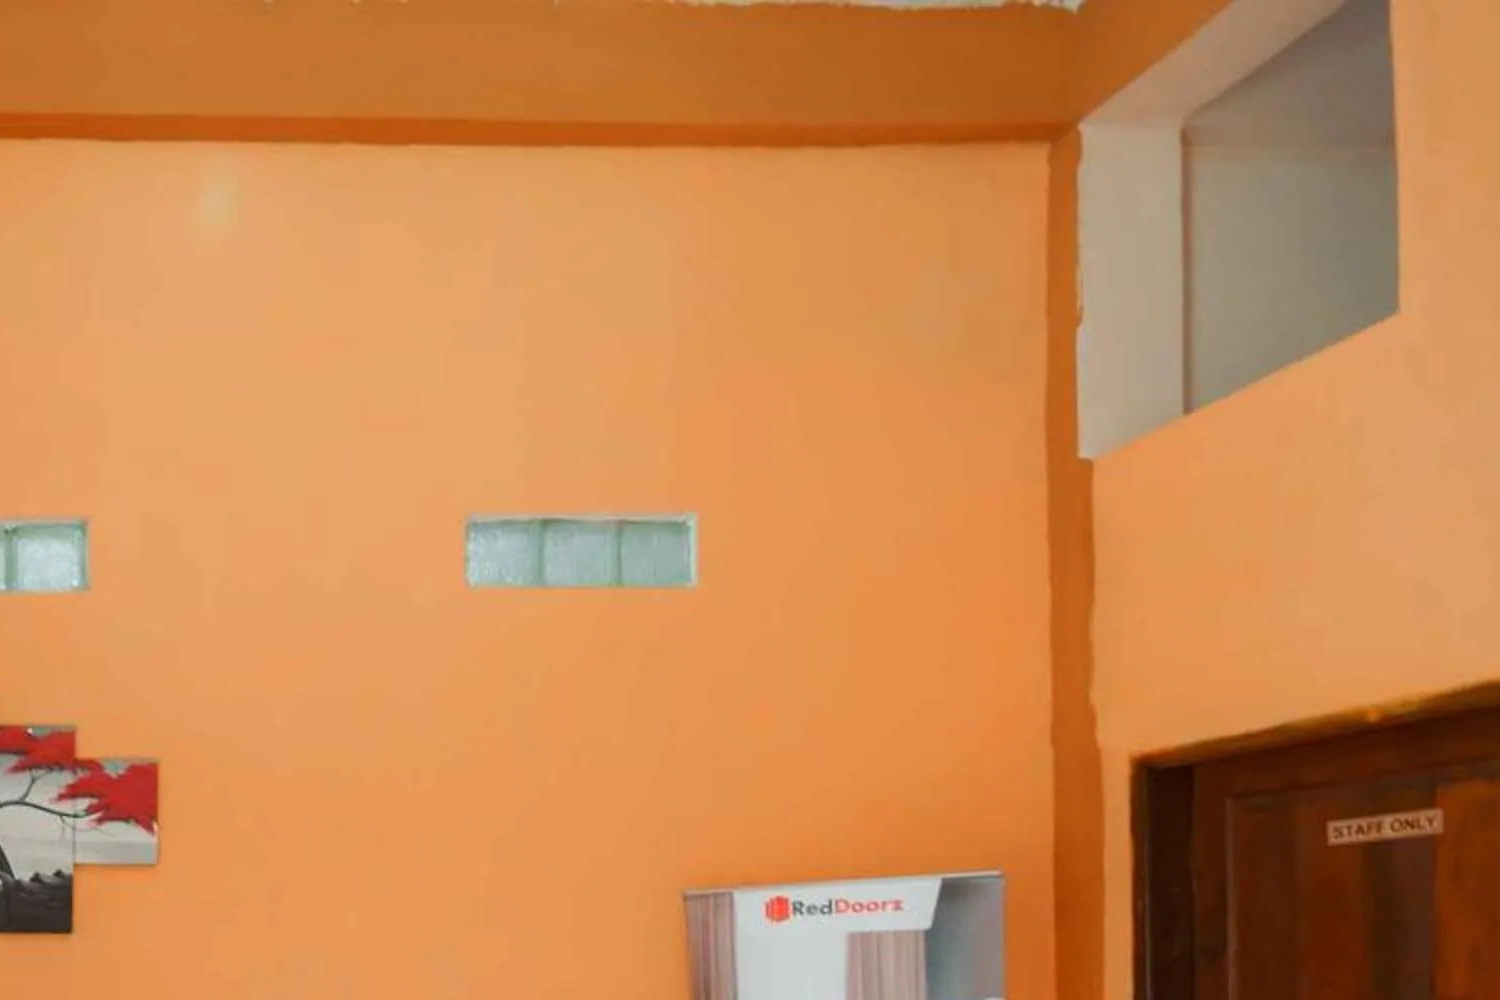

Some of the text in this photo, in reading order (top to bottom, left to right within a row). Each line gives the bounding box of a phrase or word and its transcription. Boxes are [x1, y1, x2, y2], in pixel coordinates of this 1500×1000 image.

[1333, 816, 1436, 838] STAFF ONLY
[792, 897, 904, 917] RedDoorz
